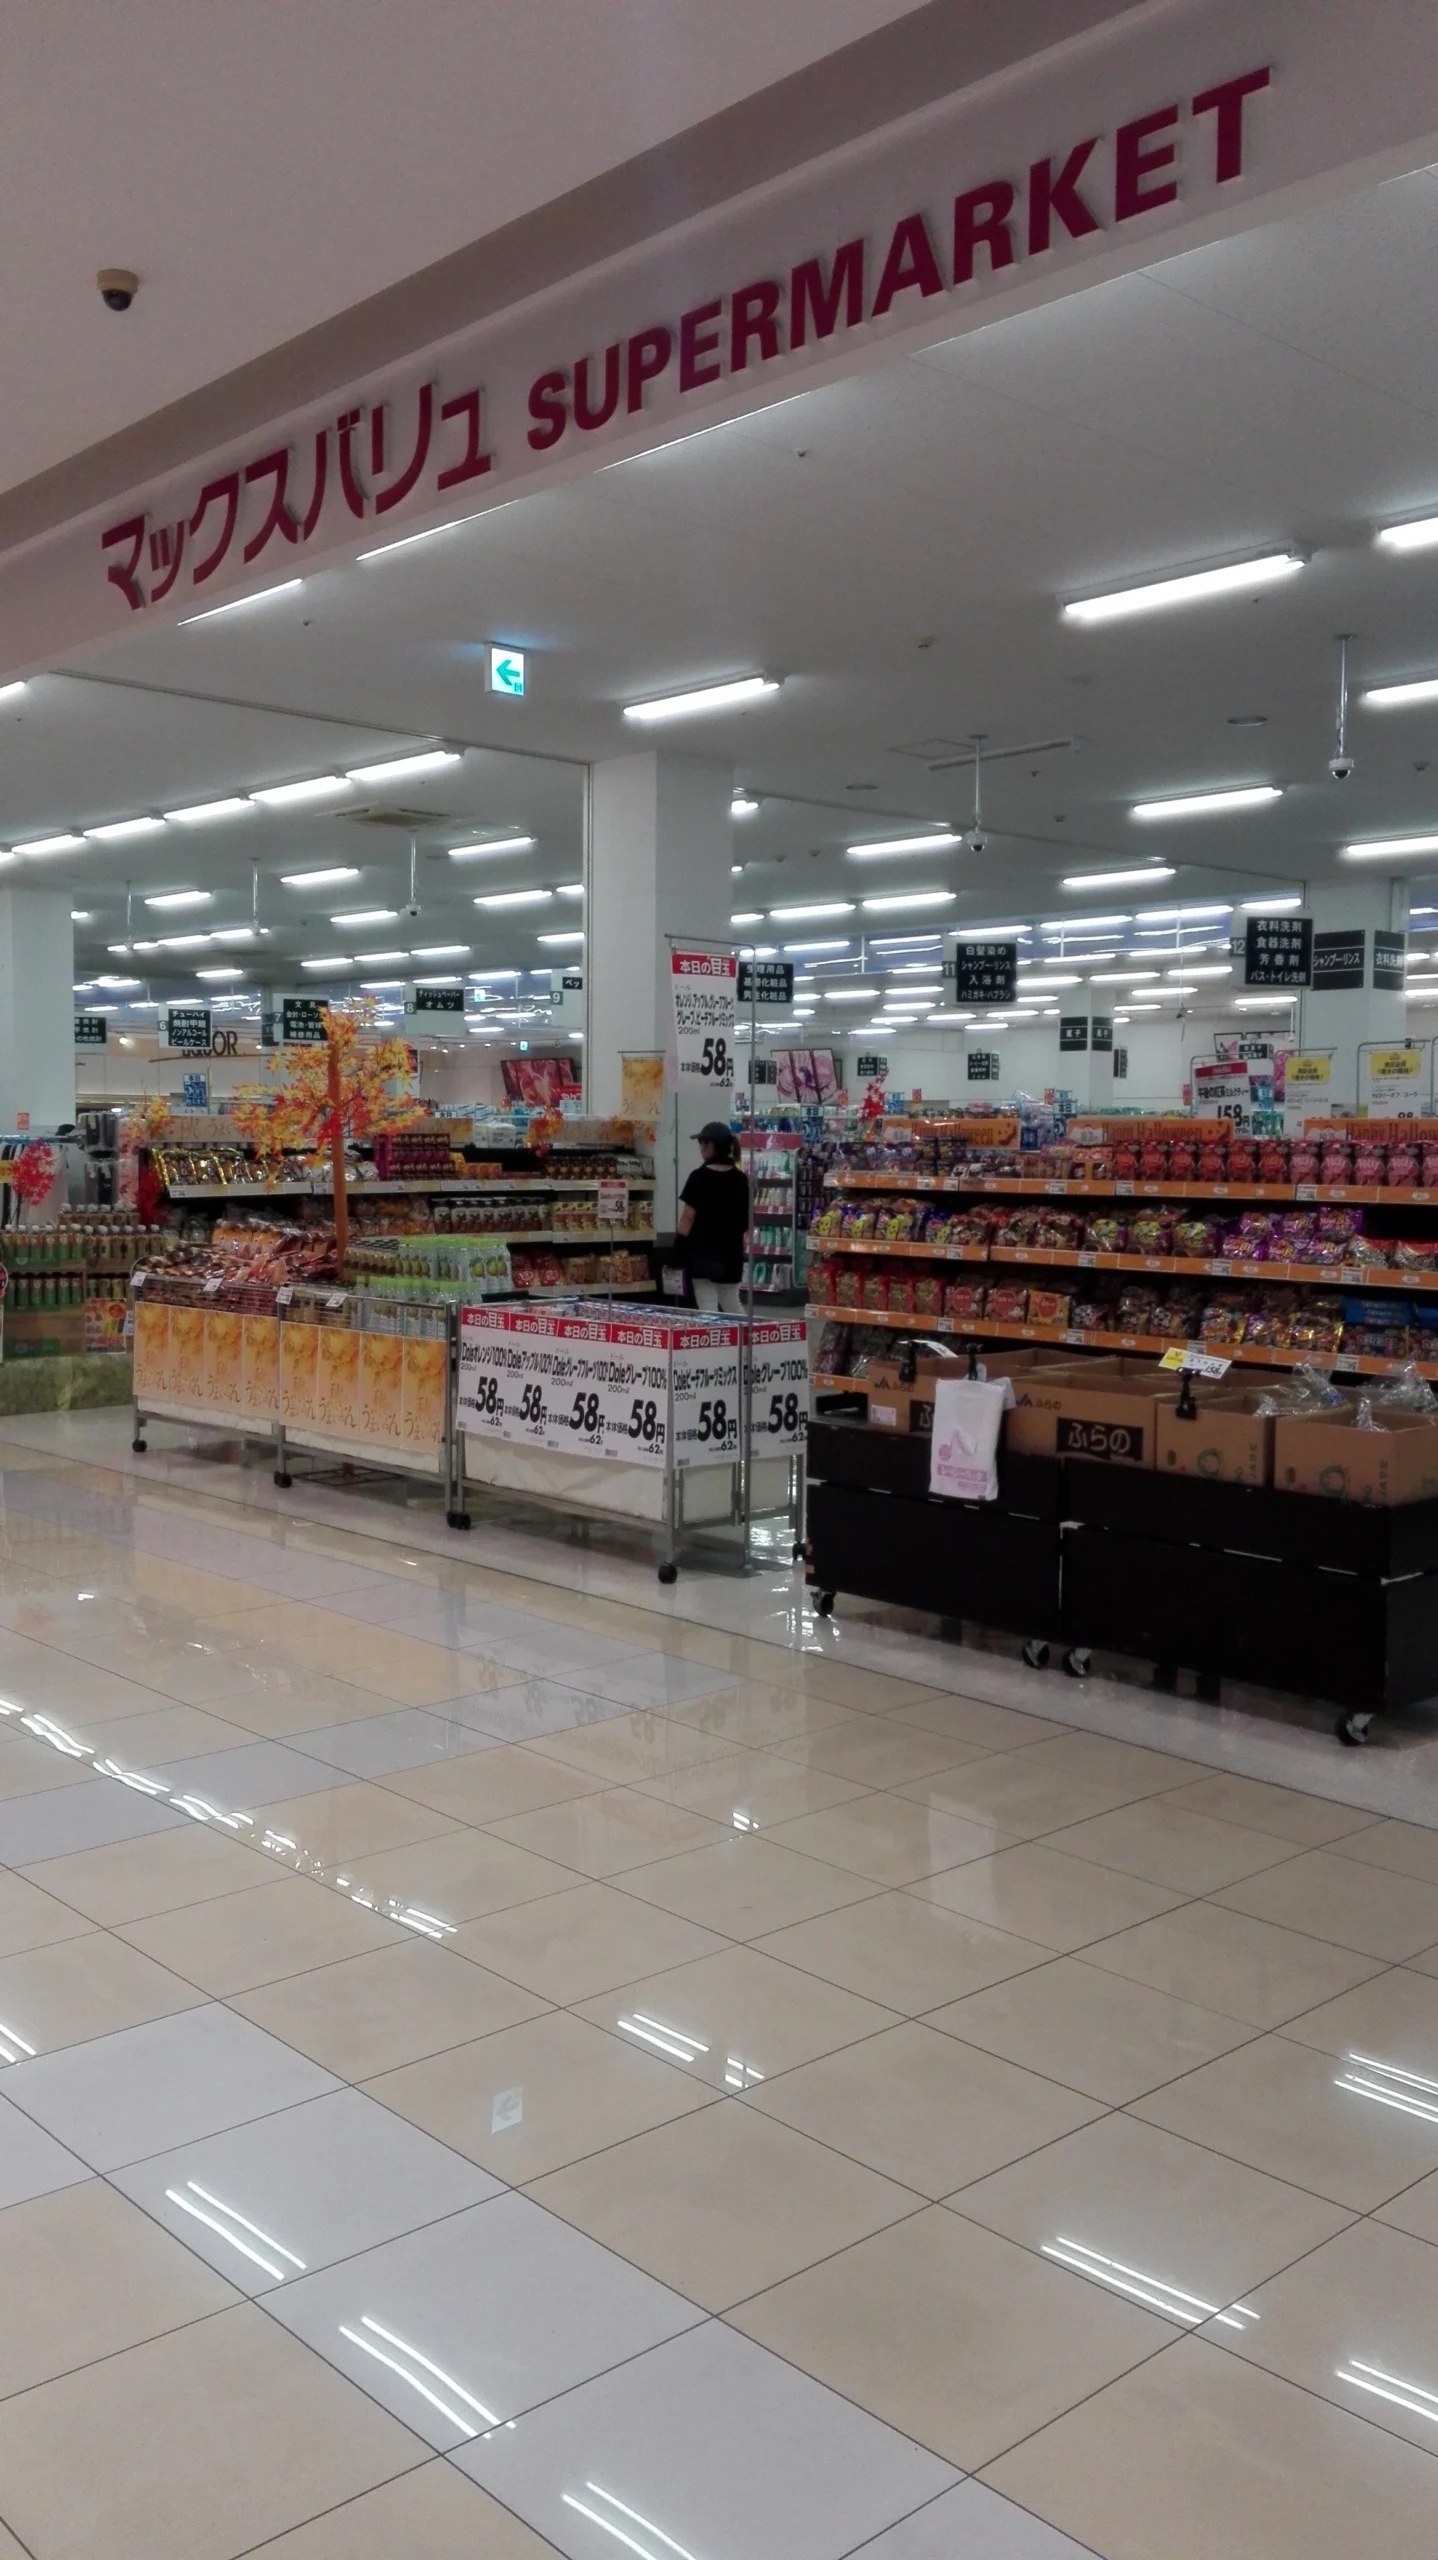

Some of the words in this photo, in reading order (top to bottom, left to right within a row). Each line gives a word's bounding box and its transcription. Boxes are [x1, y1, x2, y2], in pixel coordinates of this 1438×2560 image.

[102, 381, 492, 612] マックスバリュ
[527, 66, 1271, 453] SUPERMARKET
[1256, 919, 1302, 933] 衣料洗剤
[1231, 939, 1245, 955] 12
[1256, 936, 1302, 950] 食器洗剤
[965, 945, 1007, 956] 白髪染め
[1258, 952, 1299, 967] 芳香剤
[680, 958, 731, 976] 本日の目玉
[943, 963, 955, 976] 11
[968, 975, 1005, 986] 入浴剤
[552, 991, 561, 1003] 9
[294, 1001, 316, 1009] 文具
[406, 1002, 414, 1013] 8
[425, 1000, 455, 1009] オムツ
[172, 1010, 206, 1018] チューハイ
[274, 1013, 282, 1023] 7
[159, 1021, 166, 1030] 6
[172, 1029, 207, 1037] ノンアルコール
[171, 1038, 207, 1047] ビールケース
[467, 1311, 506, 1329] 本日の目玉
[515, 1317, 556, 1336] 本日の目玉
[564, 1323, 607, 1341] 本日の目玉
[617, 1328, 663, 1347] 本日の目玉
[680, 1329, 731, 1349] 本日の目玉
[751, 1325, 802, 1343] 本日の目玉
[460, 1363, 477, 1372] 200ml
[506, 1370, 524, 1379] 200ml
[551, 1377, 574, 1387] 200ml
[607, 1384, 630, 1394] 200ml
[674, 1392, 697, 1401] 200ml
[1067, 1421, 1132, 1455] ふらの
